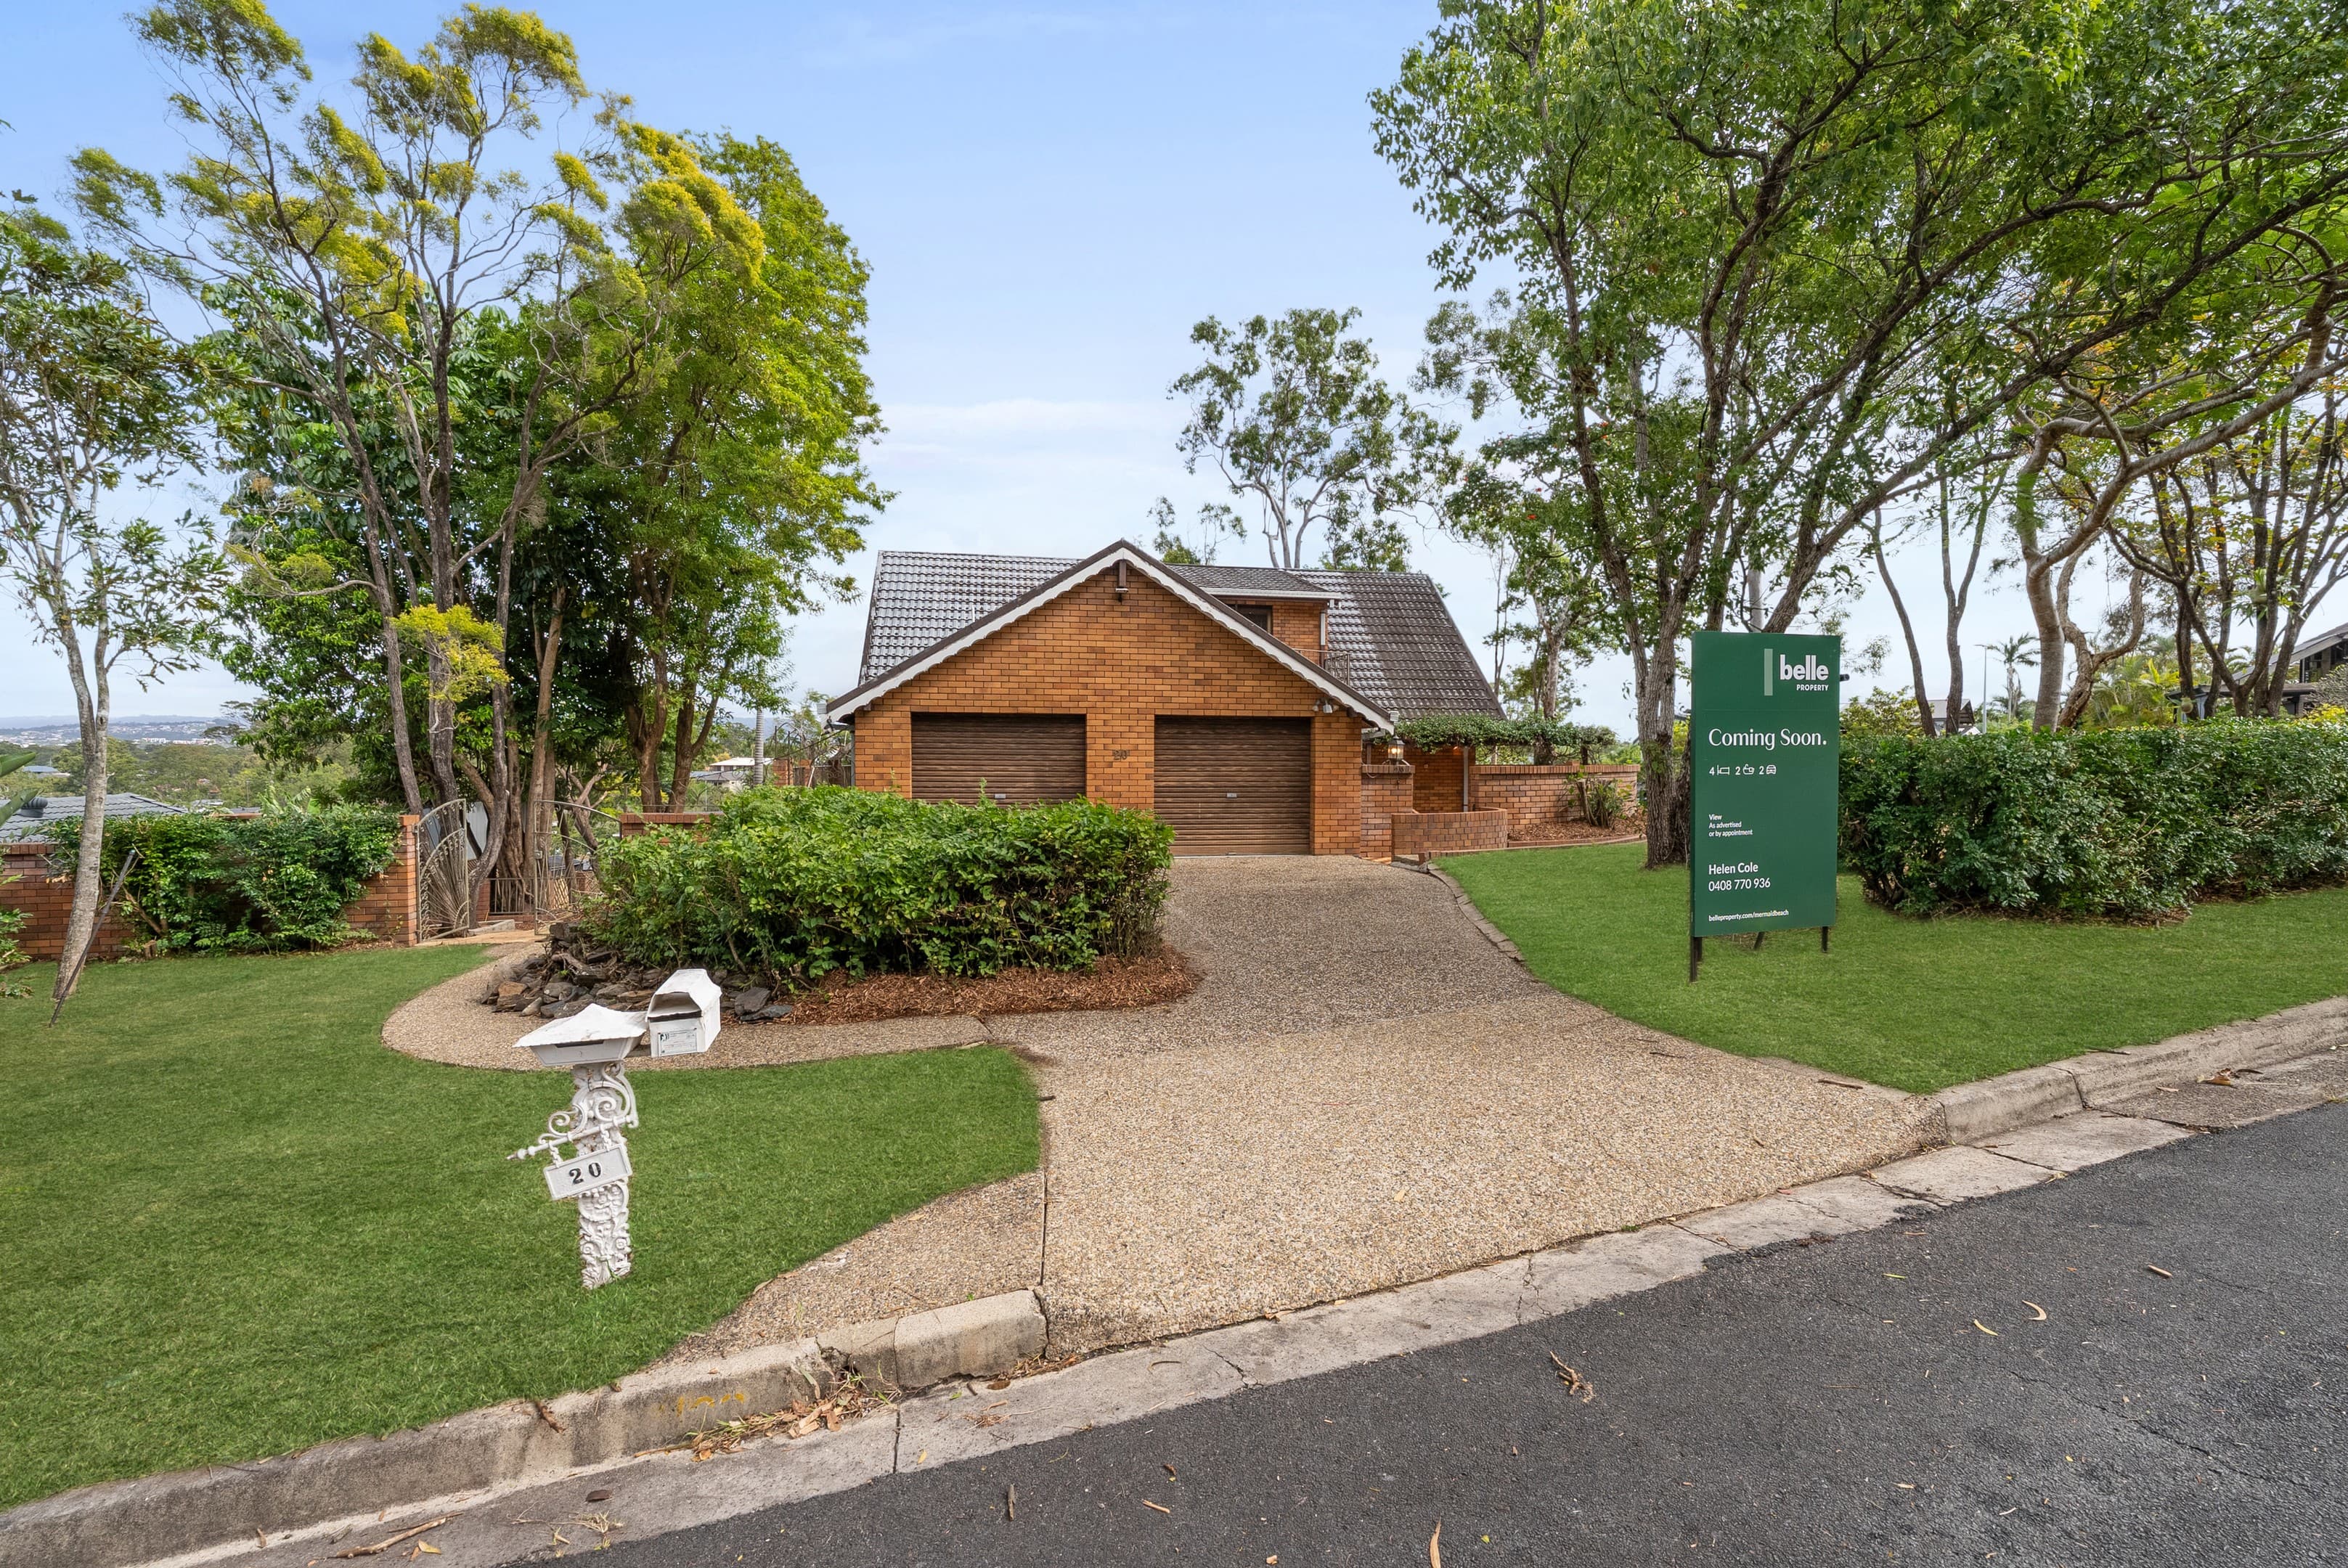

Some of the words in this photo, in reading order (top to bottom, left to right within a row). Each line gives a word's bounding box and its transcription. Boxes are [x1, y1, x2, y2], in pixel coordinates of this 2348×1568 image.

[1780, 654, 1829, 681] belle
[1708, 728, 1775, 751] Coming
[1780, 728, 1827, 746] Soon.
[1709, 767, 1715, 776] 4
[1735, 767, 1741, 775] 2
[1758, 766, 1764, 775] 2
[1708, 863, 1735, 875] Helen
[1737, 862, 1758, 873] Cole
[1708, 880, 1732, 891] 0408
[1734, 878, 1752, 890] 770
[1753, 878, 1771, 889] 936
[1708, 909, 1789, 922] belleproperty.com/mermaidbeach
[569, 1162, 601, 1184] 20
